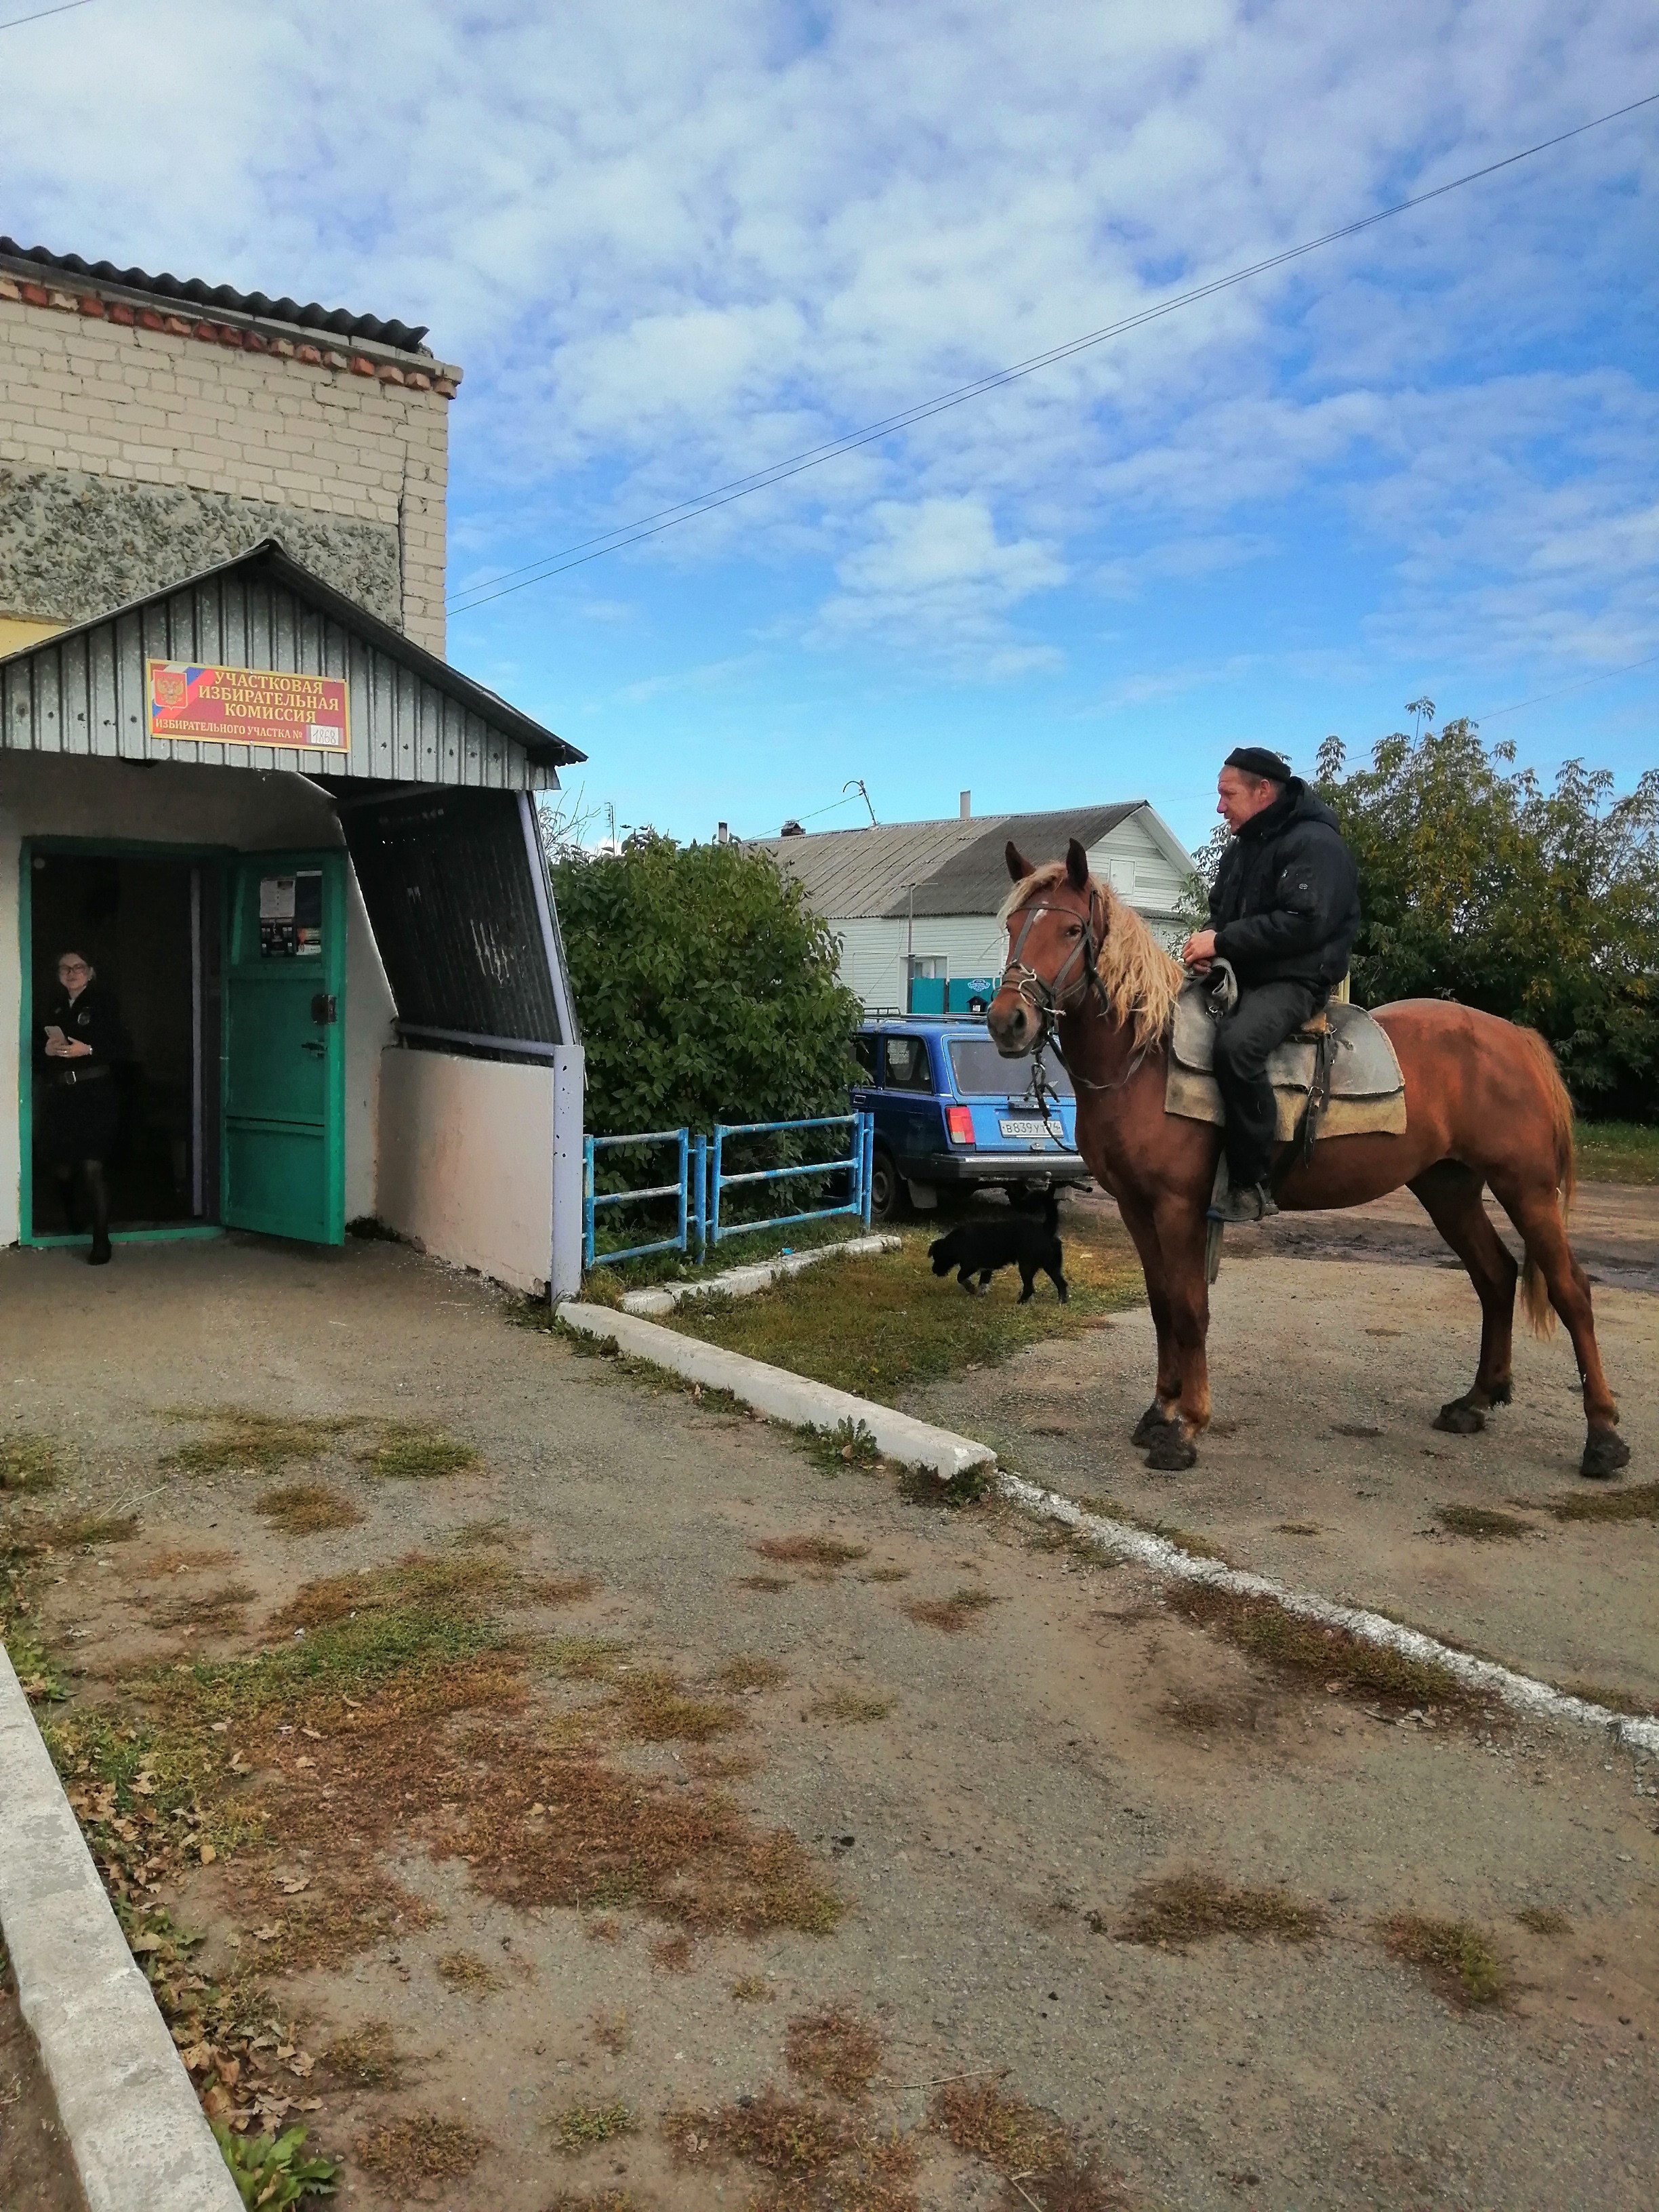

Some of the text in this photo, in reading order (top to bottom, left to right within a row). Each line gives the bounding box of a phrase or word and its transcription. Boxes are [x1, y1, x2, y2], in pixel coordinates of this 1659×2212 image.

[214, 671, 324, 695] УЧАСТКОВАЯ
[199, 684, 339, 711] ИЗБИРАТЕЛЬНАЯ
[224, 703, 316, 724] КОМИССИЯ
[155, 718, 336, 745] ИЗБИРАТЕЛЬНОГО УЧАСТКА № 1868
